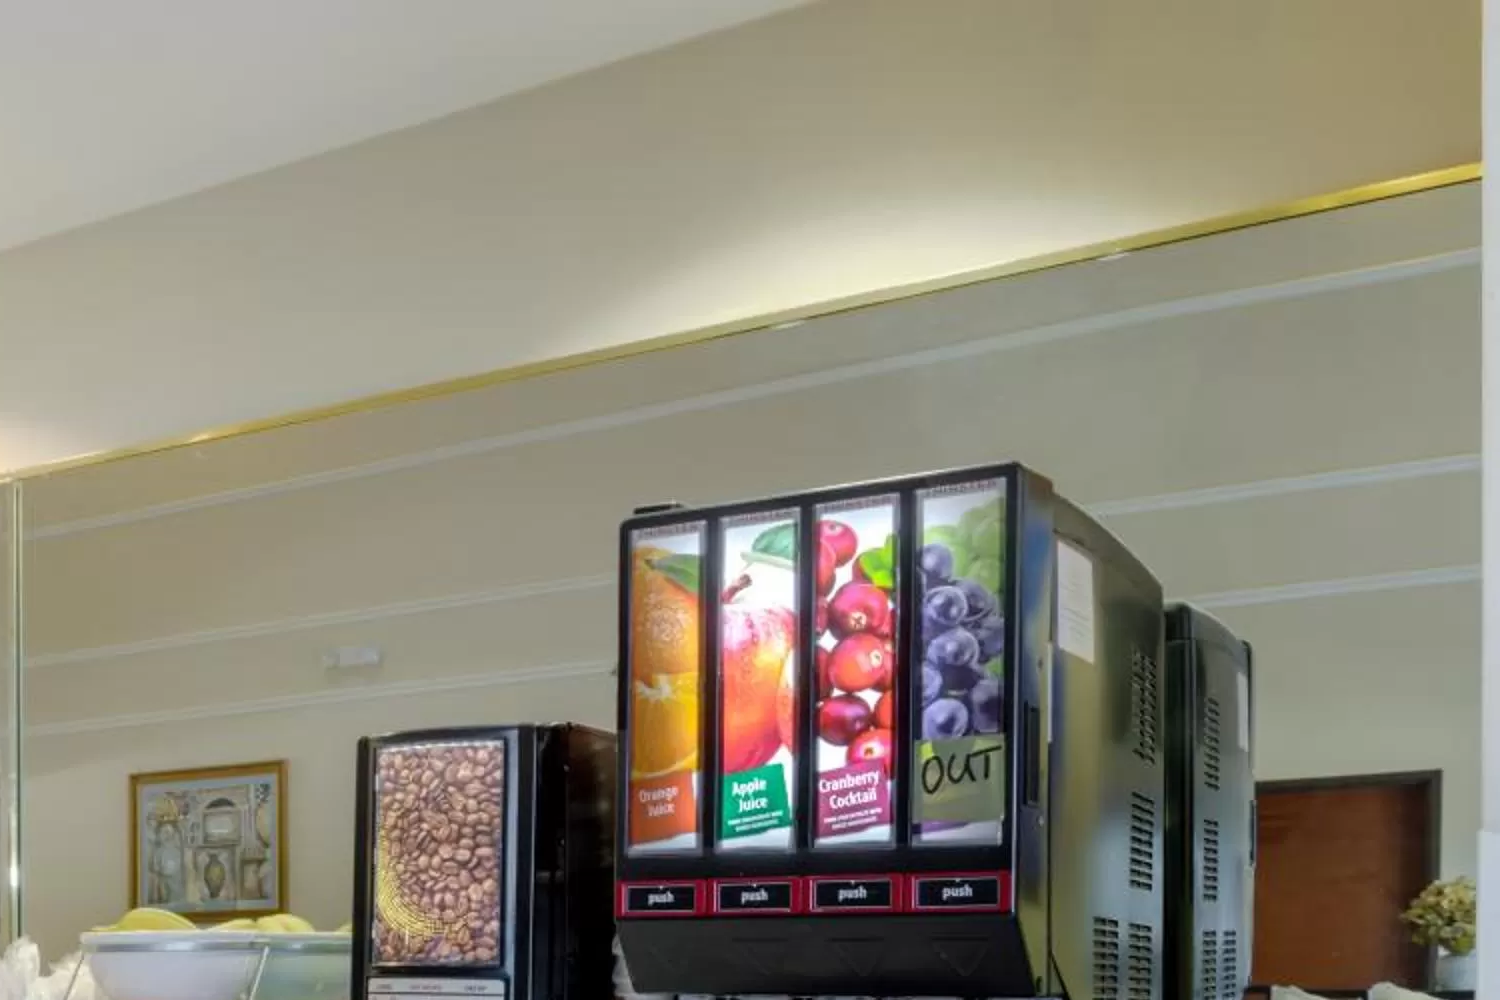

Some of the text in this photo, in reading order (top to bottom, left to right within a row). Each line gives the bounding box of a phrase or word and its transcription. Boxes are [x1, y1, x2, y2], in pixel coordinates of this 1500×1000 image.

[922, 745, 1002, 794] OUT
[732, 777, 767, 797] Apple
[819, 770, 879, 793] Cranberry
[639, 786, 679, 802] Orange
[829, 787, 877, 809] Cocktail
[647, 803, 675, 817] Juice
[739, 796, 768, 813] Juice
[648, 890, 675, 906] push
[741, 888, 769, 904] push
[838, 885, 867, 902] push
[942, 883, 973, 901] push
